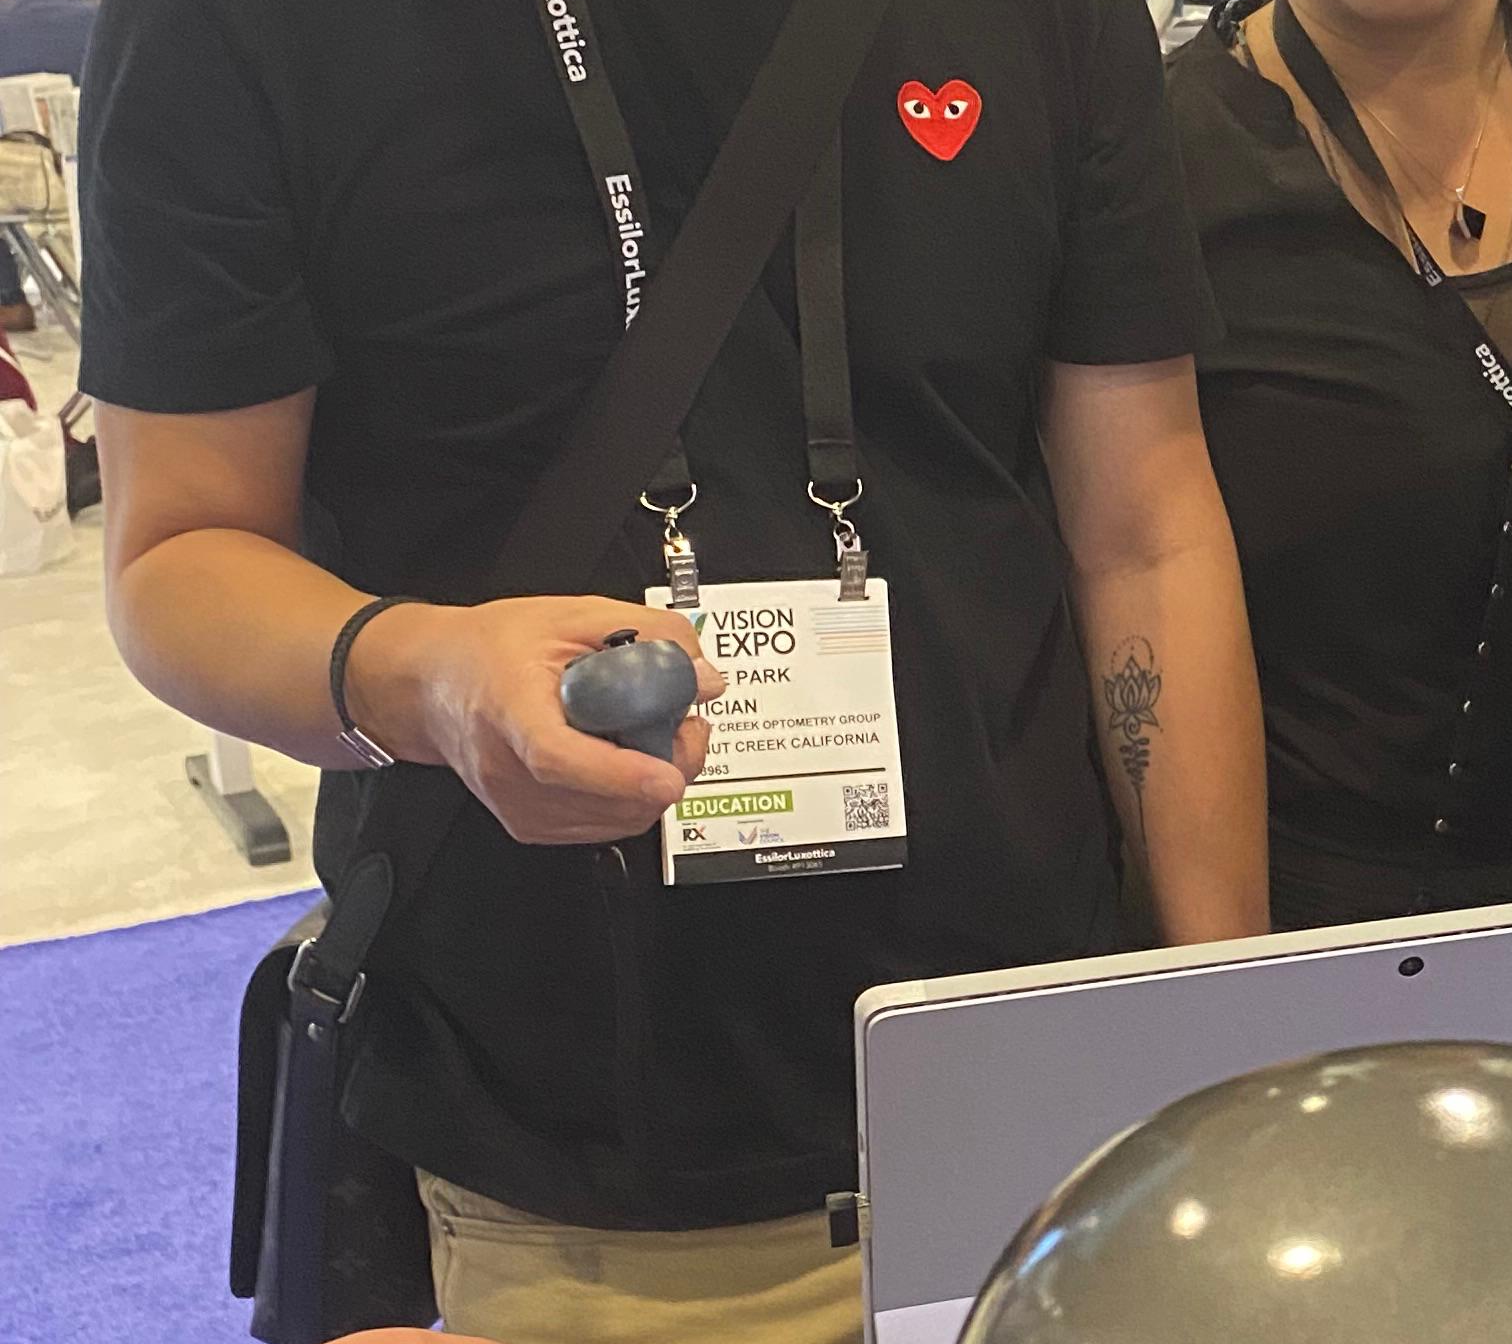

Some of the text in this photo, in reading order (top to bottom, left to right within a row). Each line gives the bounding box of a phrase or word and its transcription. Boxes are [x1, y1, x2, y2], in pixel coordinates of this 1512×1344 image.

[712, 608, 794, 631] VISION
[716, 630, 796, 658] EXPO
[737, 668, 791, 685] PARK
[719, 721, 759, 733] CREEK
[763, 717, 836, 730] OPTOMETRY
[839, 713, 881, 725] GROUP
[735, 739, 787, 753] CREEK
[791, 732, 880, 749] CALIFORNIA
[681, 793, 787, 817] EDUCATION
[755, 849, 836, 865] EssilorLuxottica
